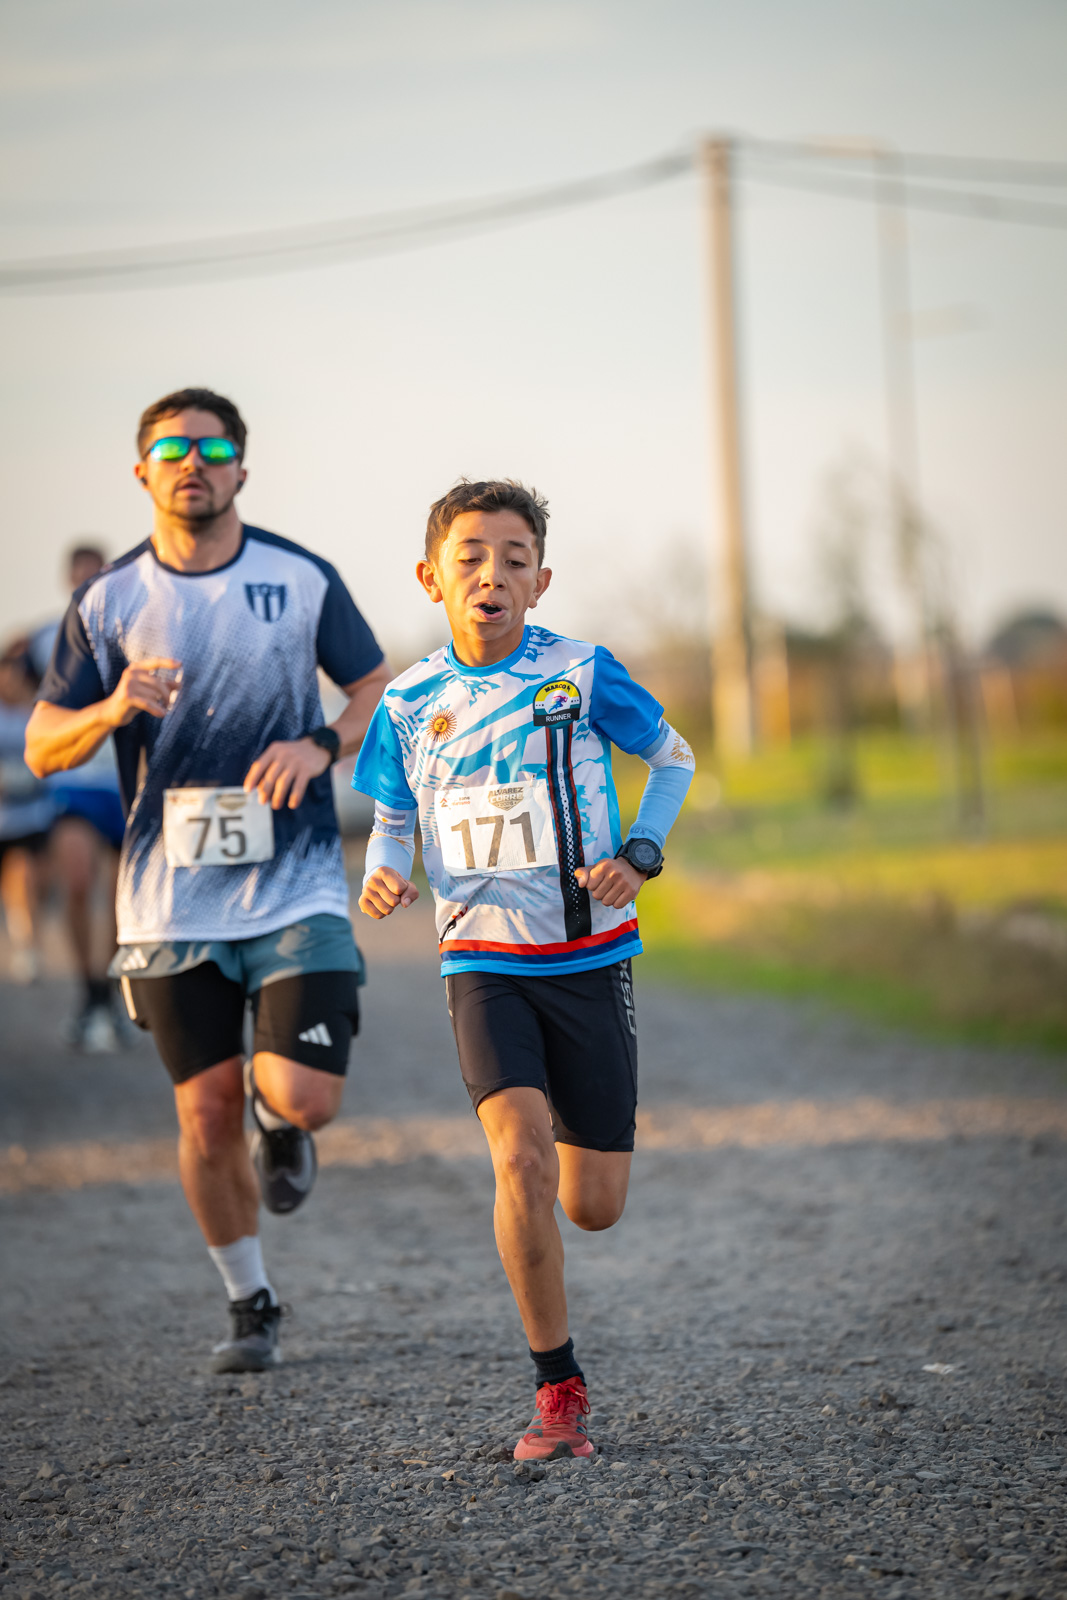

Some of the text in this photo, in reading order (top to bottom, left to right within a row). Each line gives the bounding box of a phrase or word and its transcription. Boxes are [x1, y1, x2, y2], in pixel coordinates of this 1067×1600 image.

[545, 713, 572, 722] RUNNER
[488, 787, 524, 797] ALVAREZ
[490, 793, 523, 803] CORRE
[187, 816, 247, 860] 75
[451, 811, 537, 870] 171
